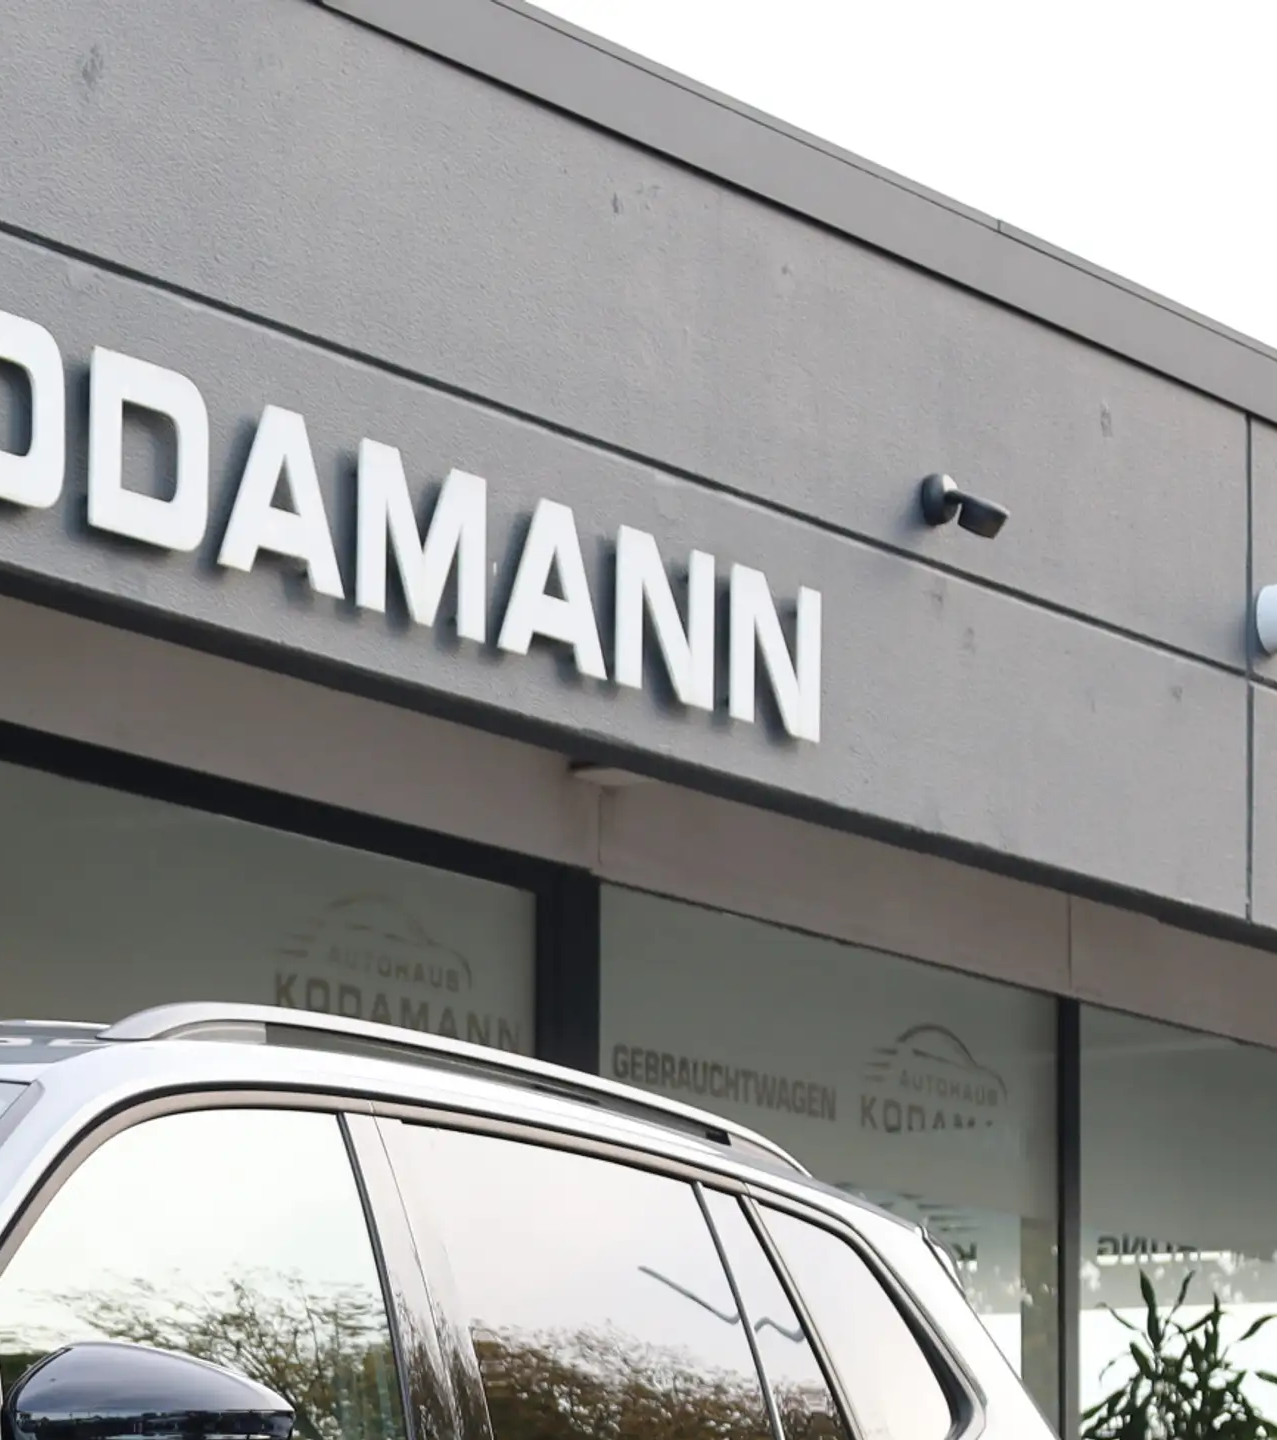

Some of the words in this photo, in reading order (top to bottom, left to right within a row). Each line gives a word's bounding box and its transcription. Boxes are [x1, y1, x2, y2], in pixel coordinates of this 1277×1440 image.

[327, 944, 460, 993] AUTOHAUS
[612, 1044, 837, 1122] GEBRAUCHTWAGEN
[899, 1068, 999, 1107] AUTOHAUS
